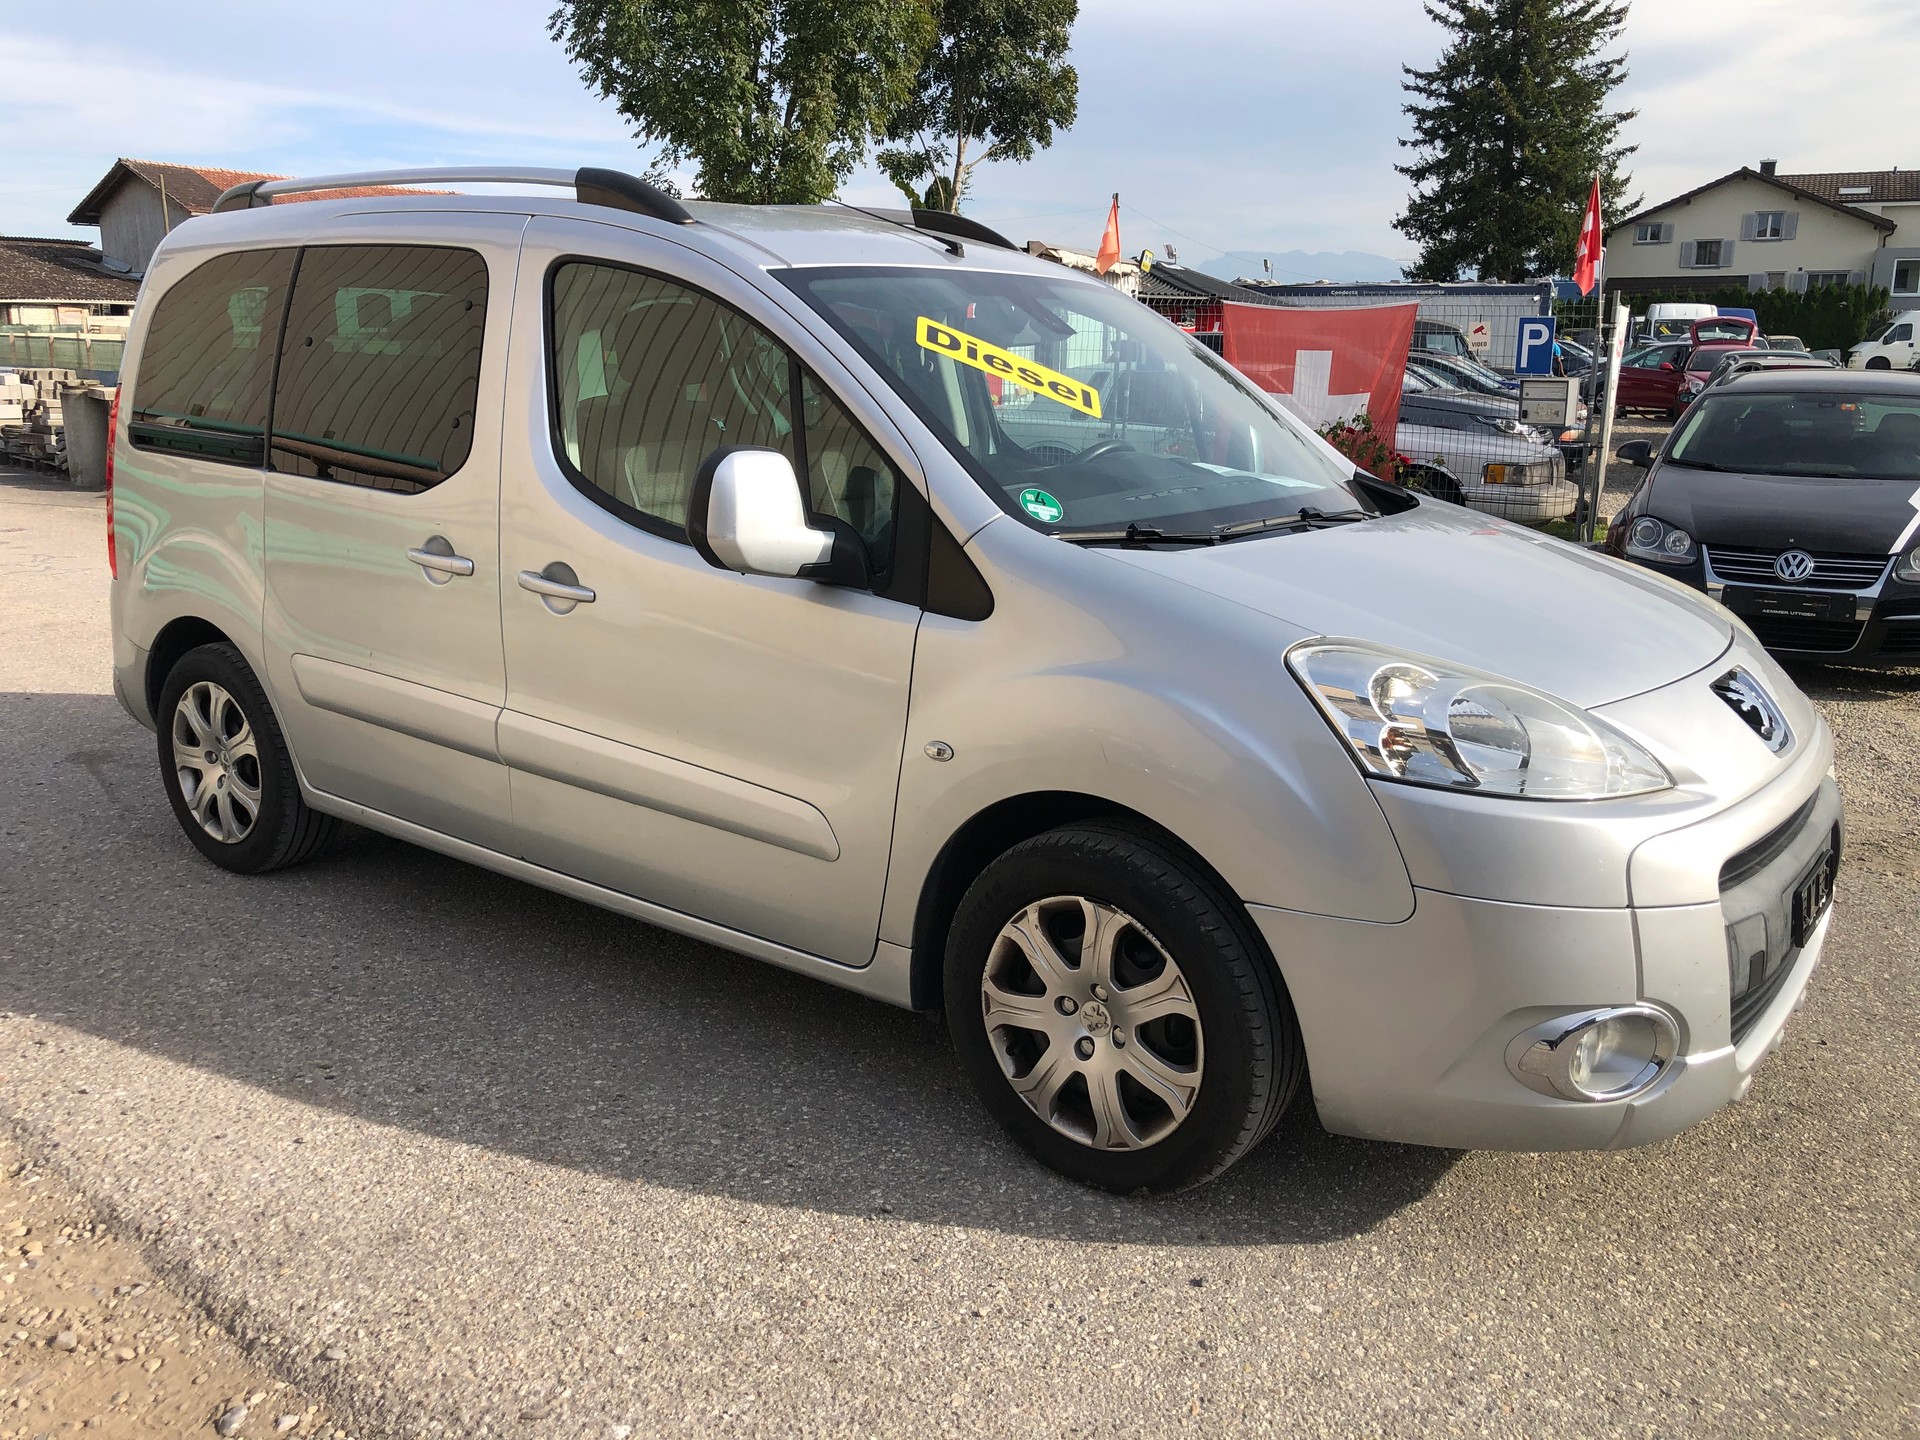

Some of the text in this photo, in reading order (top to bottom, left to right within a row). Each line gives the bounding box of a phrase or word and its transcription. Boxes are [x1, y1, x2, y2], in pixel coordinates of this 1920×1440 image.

[1520, 323, 1550, 368] P
[926, 324, 1093, 410] Diesel
[1034, 491, 1047, 506] 4
[1776, 551, 1812, 580] VW
